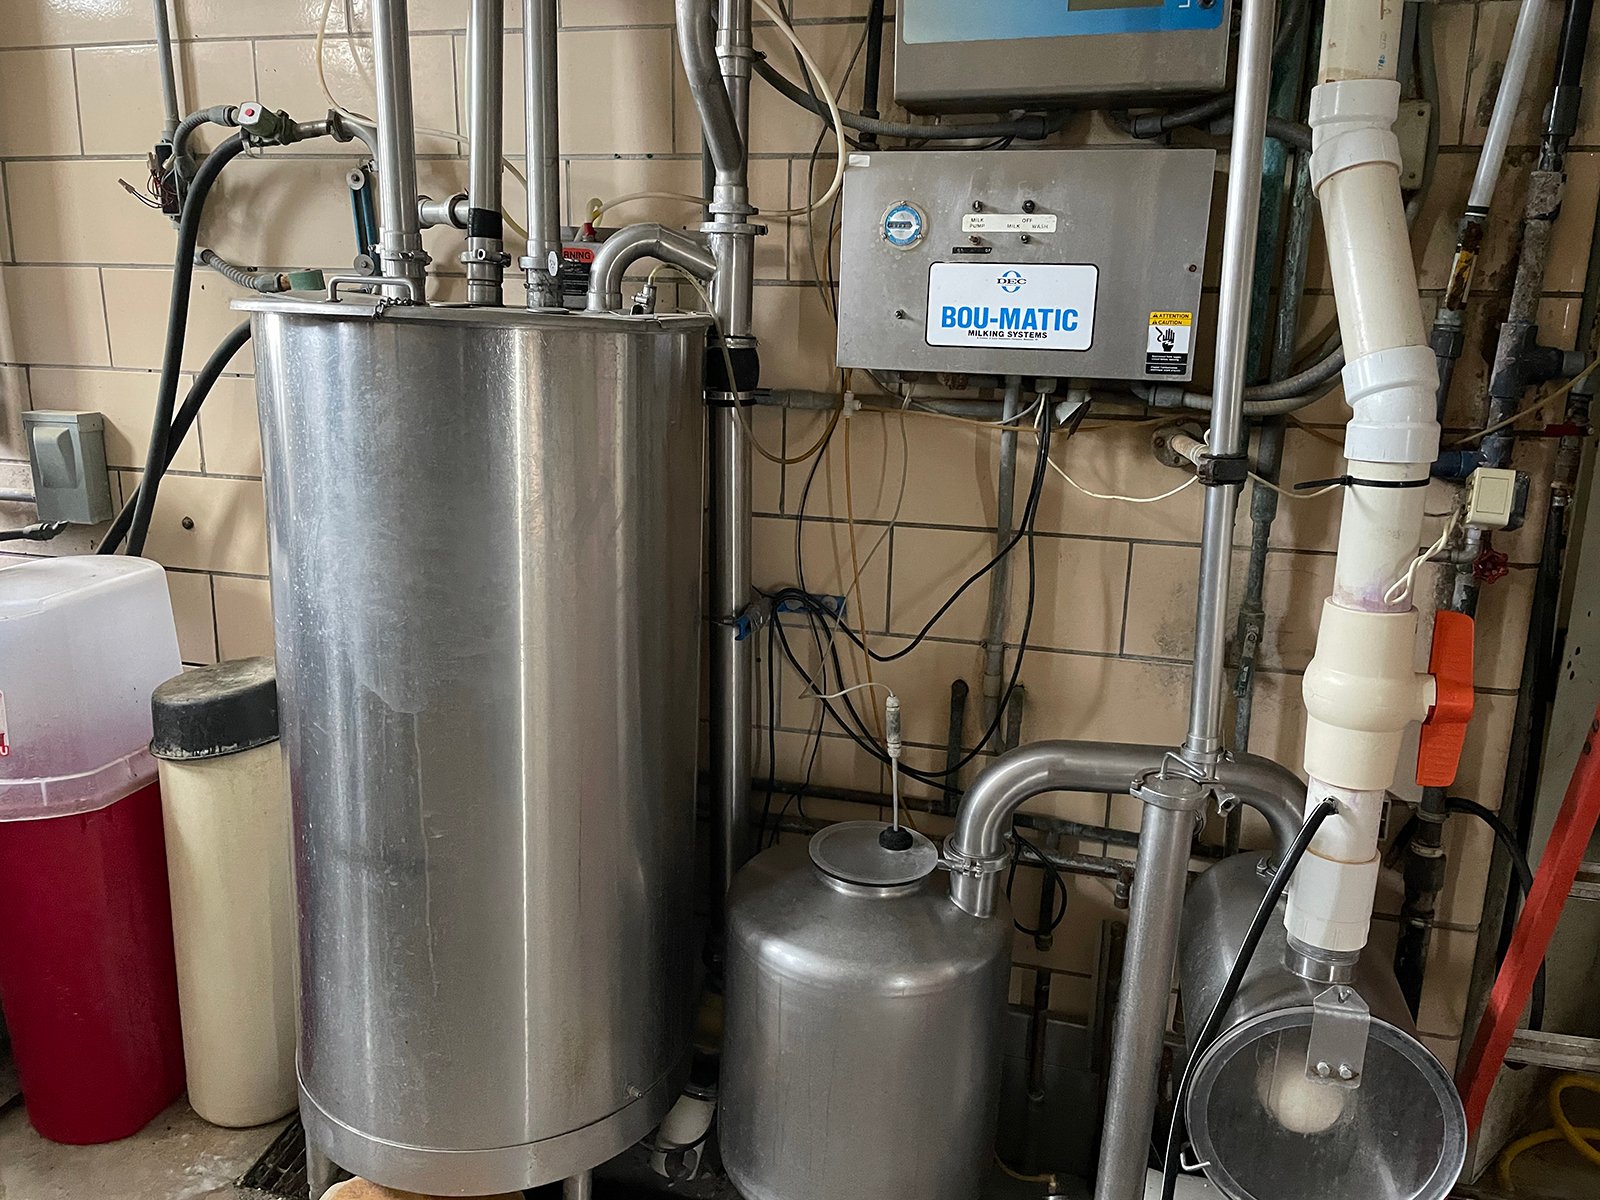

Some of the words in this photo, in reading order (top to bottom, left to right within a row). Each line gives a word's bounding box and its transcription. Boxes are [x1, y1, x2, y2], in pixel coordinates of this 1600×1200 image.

[563, 251, 591, 260] RNING
[941, 306, 1079, 332] BOU-MATIC
[968, 330, 1005, 338] MILKING
[1006, 331, 1048, 339] SYSTEMS
